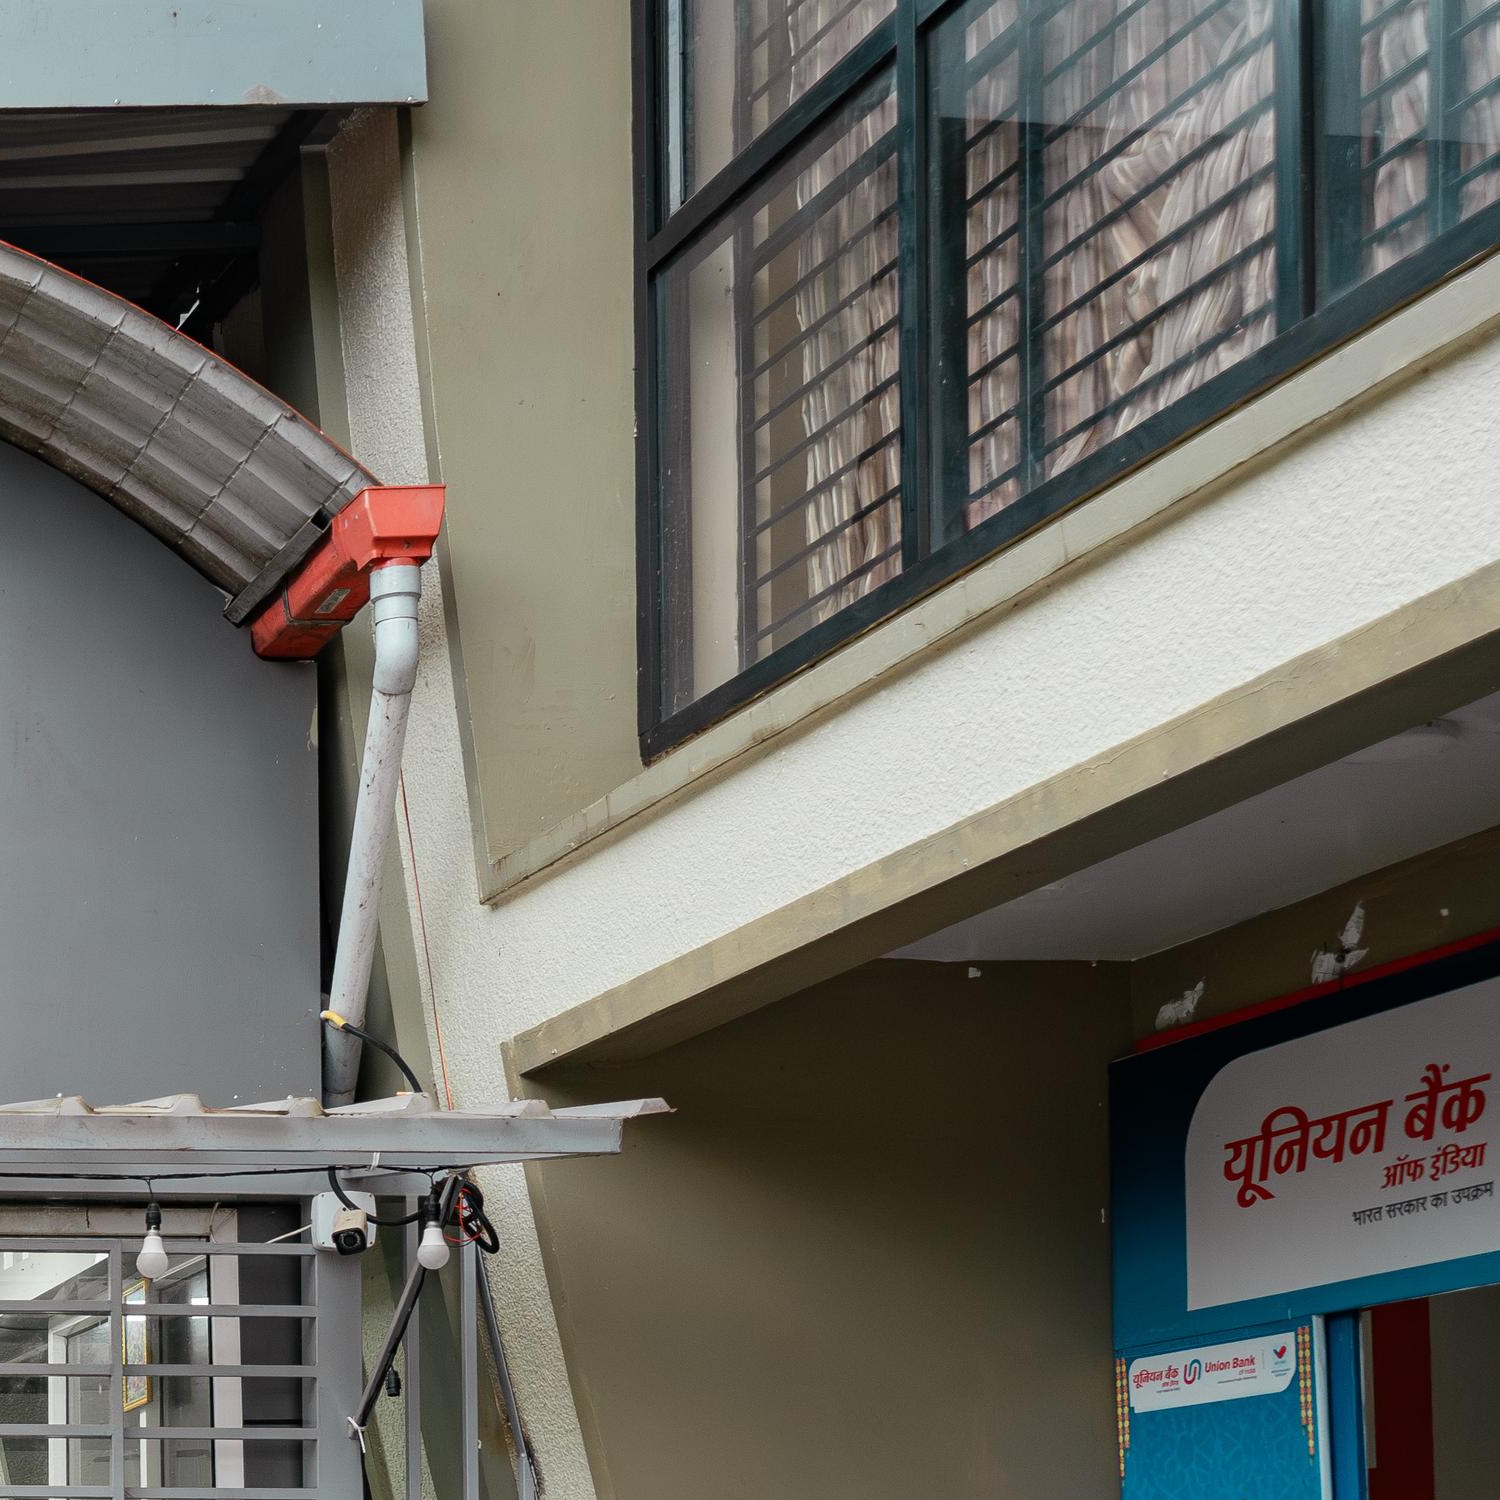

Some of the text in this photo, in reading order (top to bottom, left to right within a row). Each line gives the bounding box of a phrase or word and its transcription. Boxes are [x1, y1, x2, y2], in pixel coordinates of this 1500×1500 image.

[1223, 1063, 1492, 1208] यूनियन बैंक
[1381, 1143, 1488, 1189] ऑफ इंडिया
[1352, 1180, 1494, 1225] भारत सरकार का उपक्रम
[1204, 1355, 1256, 1374] Union Bank
